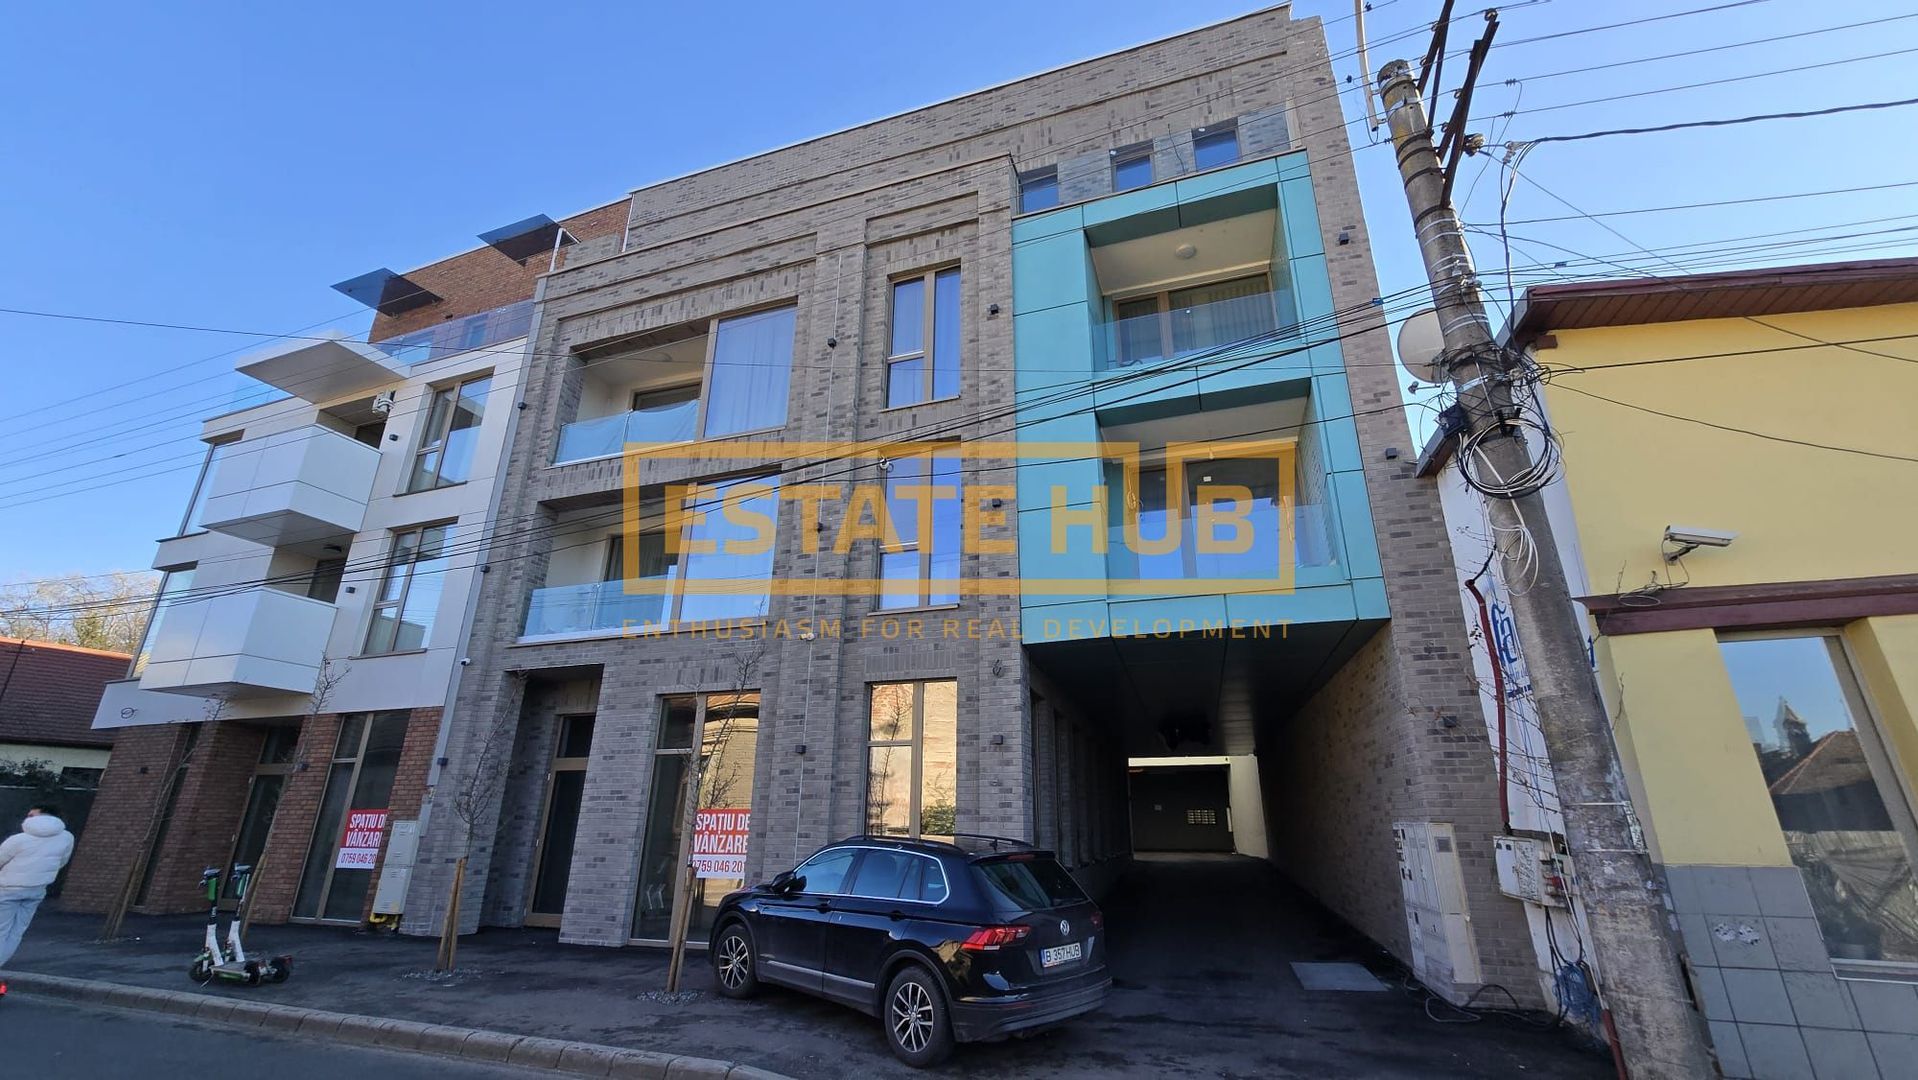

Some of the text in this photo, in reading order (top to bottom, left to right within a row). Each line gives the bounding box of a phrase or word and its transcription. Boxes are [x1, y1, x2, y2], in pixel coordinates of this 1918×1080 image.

[737, 813, 751, 831] DE
[694, 831, 749, 853] VÂNZARE
[713, 860, 730, 873] 046
[1045, 950, 1051, 962] B
